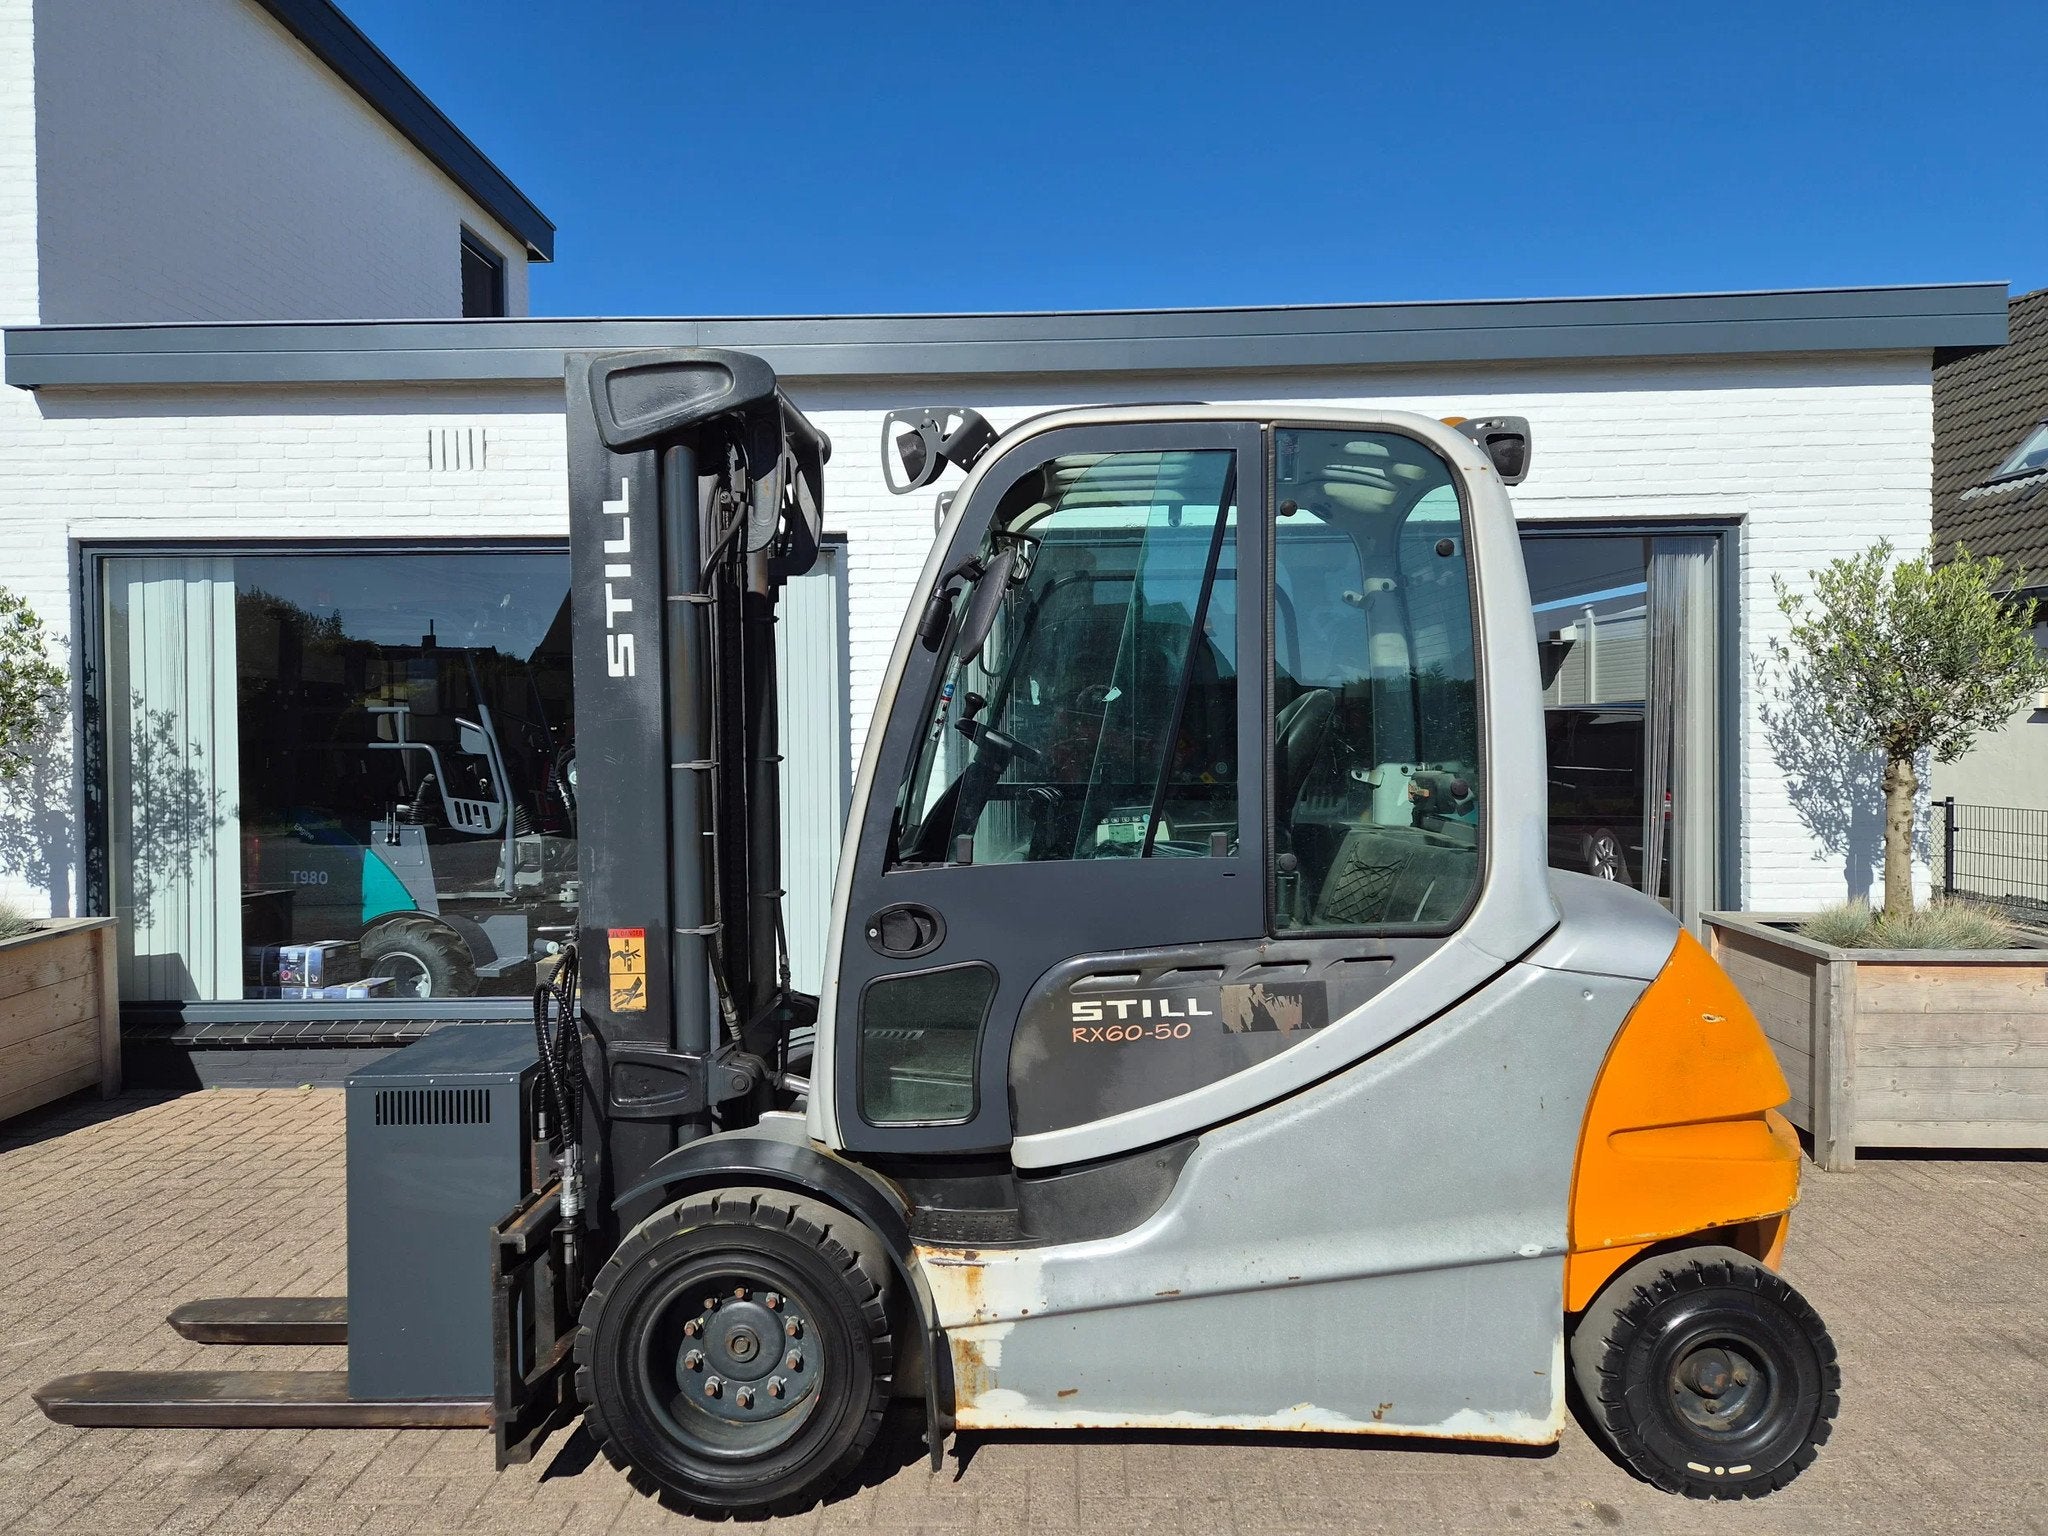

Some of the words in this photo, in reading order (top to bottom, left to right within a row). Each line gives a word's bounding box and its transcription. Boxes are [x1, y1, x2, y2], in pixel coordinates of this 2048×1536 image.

[603, 477, 635, 677] STILL
[294, 822, 315, 840] Engine
[290, 870, 328, 885] T980
[1072, 998, 1212, 1022] STILL
[1072, 1023, 1191, 1043] RX60-50
